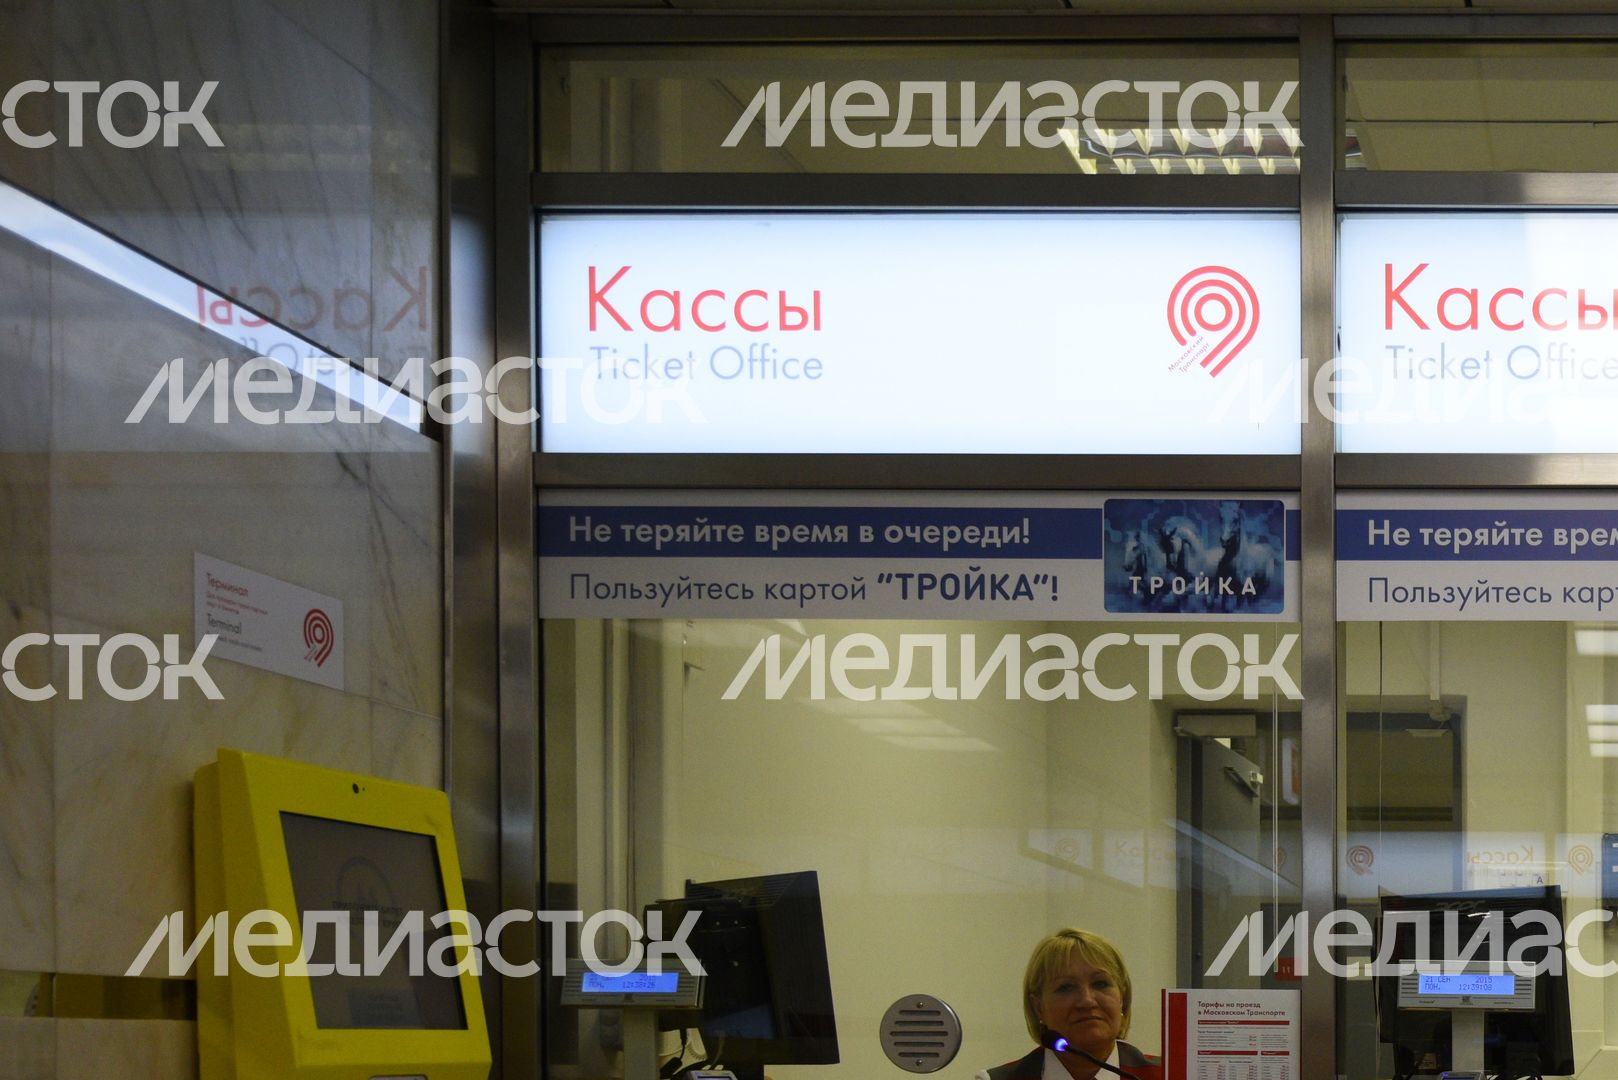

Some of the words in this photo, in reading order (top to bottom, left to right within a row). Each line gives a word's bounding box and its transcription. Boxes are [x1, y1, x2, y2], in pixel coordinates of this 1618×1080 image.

[589, 266, 820, 332] Кассы
[590, 344, 694, 381] Ticket
[710, 344, 822, 381] Office
[1386, 342, 1493, 380] Ticket
[570, 516, 611, 542] Не
[621, 518, 744, 550] теряйте
[756, 525, 848, 550] время
[860, 526, 874, 542] в
[885, 518, 1029, 551] очереди!
[1369, 520, 1410, 545] Не
[1420, 521, 1542, 553] теряйте
[571, 574, 753, 607] Пользуйтесь
[765, 577, 865, 608] картой
[1129, 572, 1258, 596] ТРОЙКА
[1369, 578, 1551, 611] Пользуйтесь
